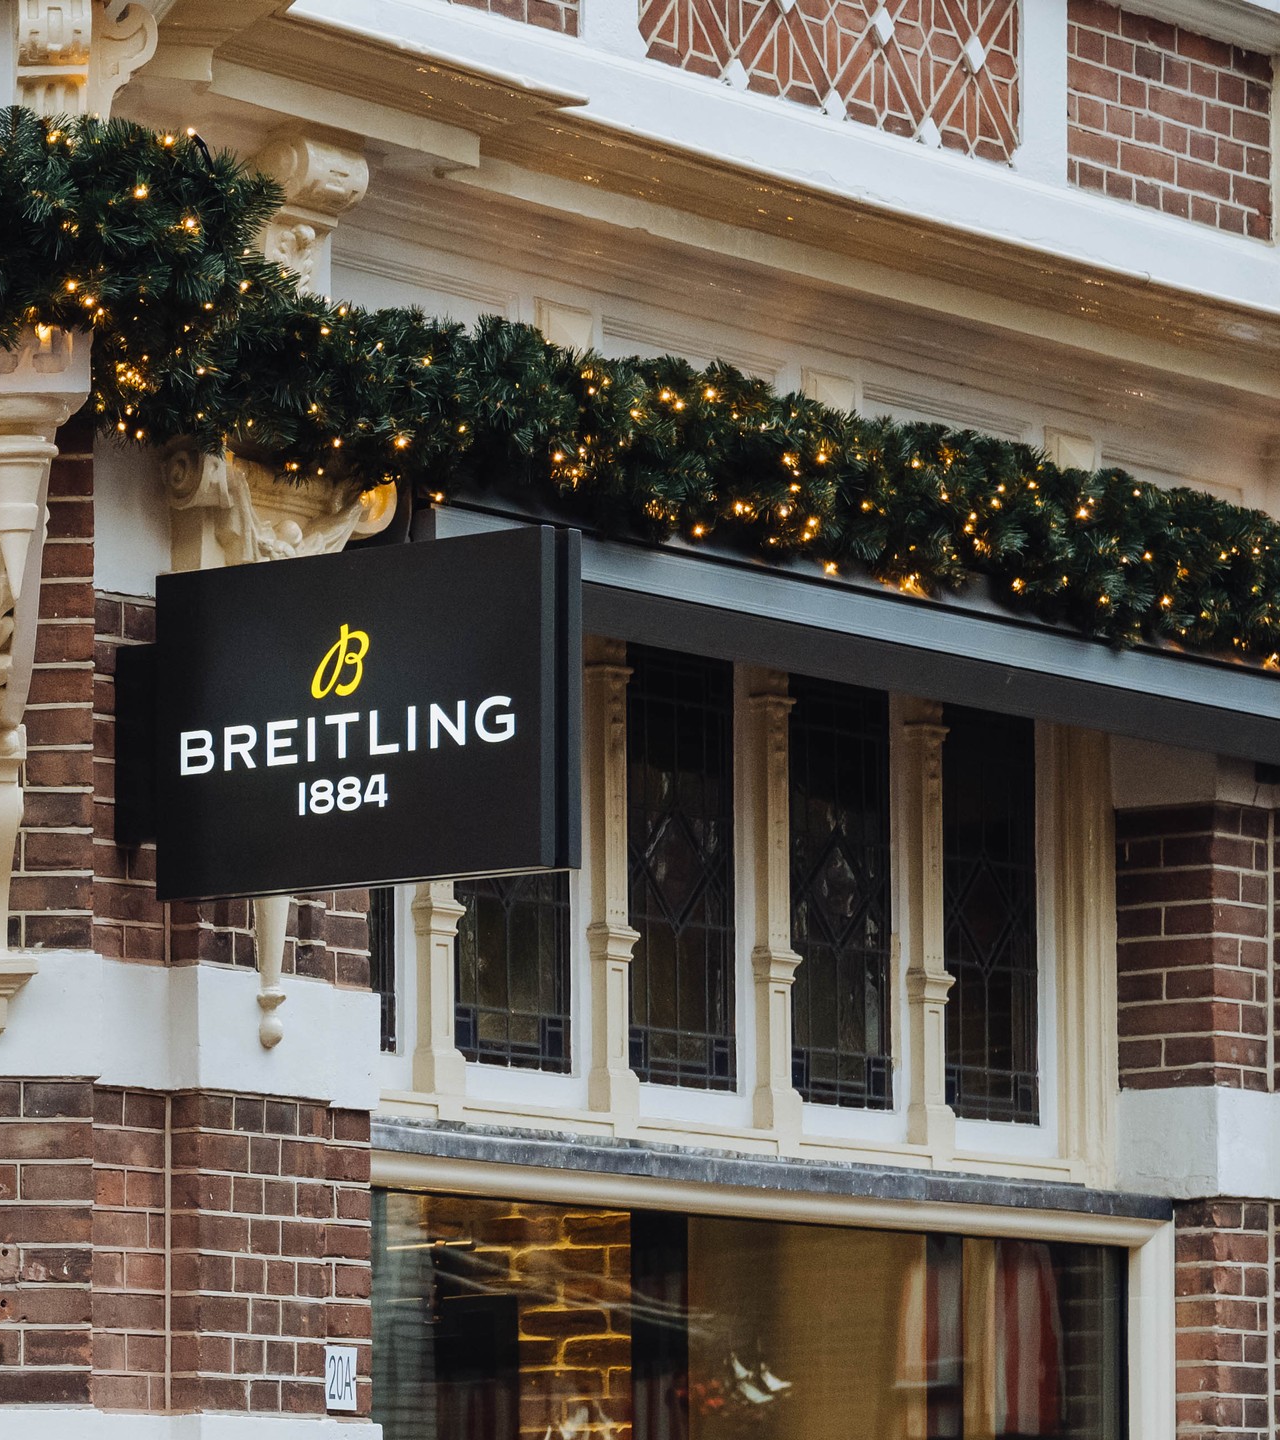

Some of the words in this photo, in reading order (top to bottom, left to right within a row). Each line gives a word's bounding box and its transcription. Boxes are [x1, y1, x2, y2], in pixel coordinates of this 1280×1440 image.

[180, 695, 516, 776] BREITLING
[298, 773, 389, 816] 1884
[329, 1355, 353, 1401] 20A
